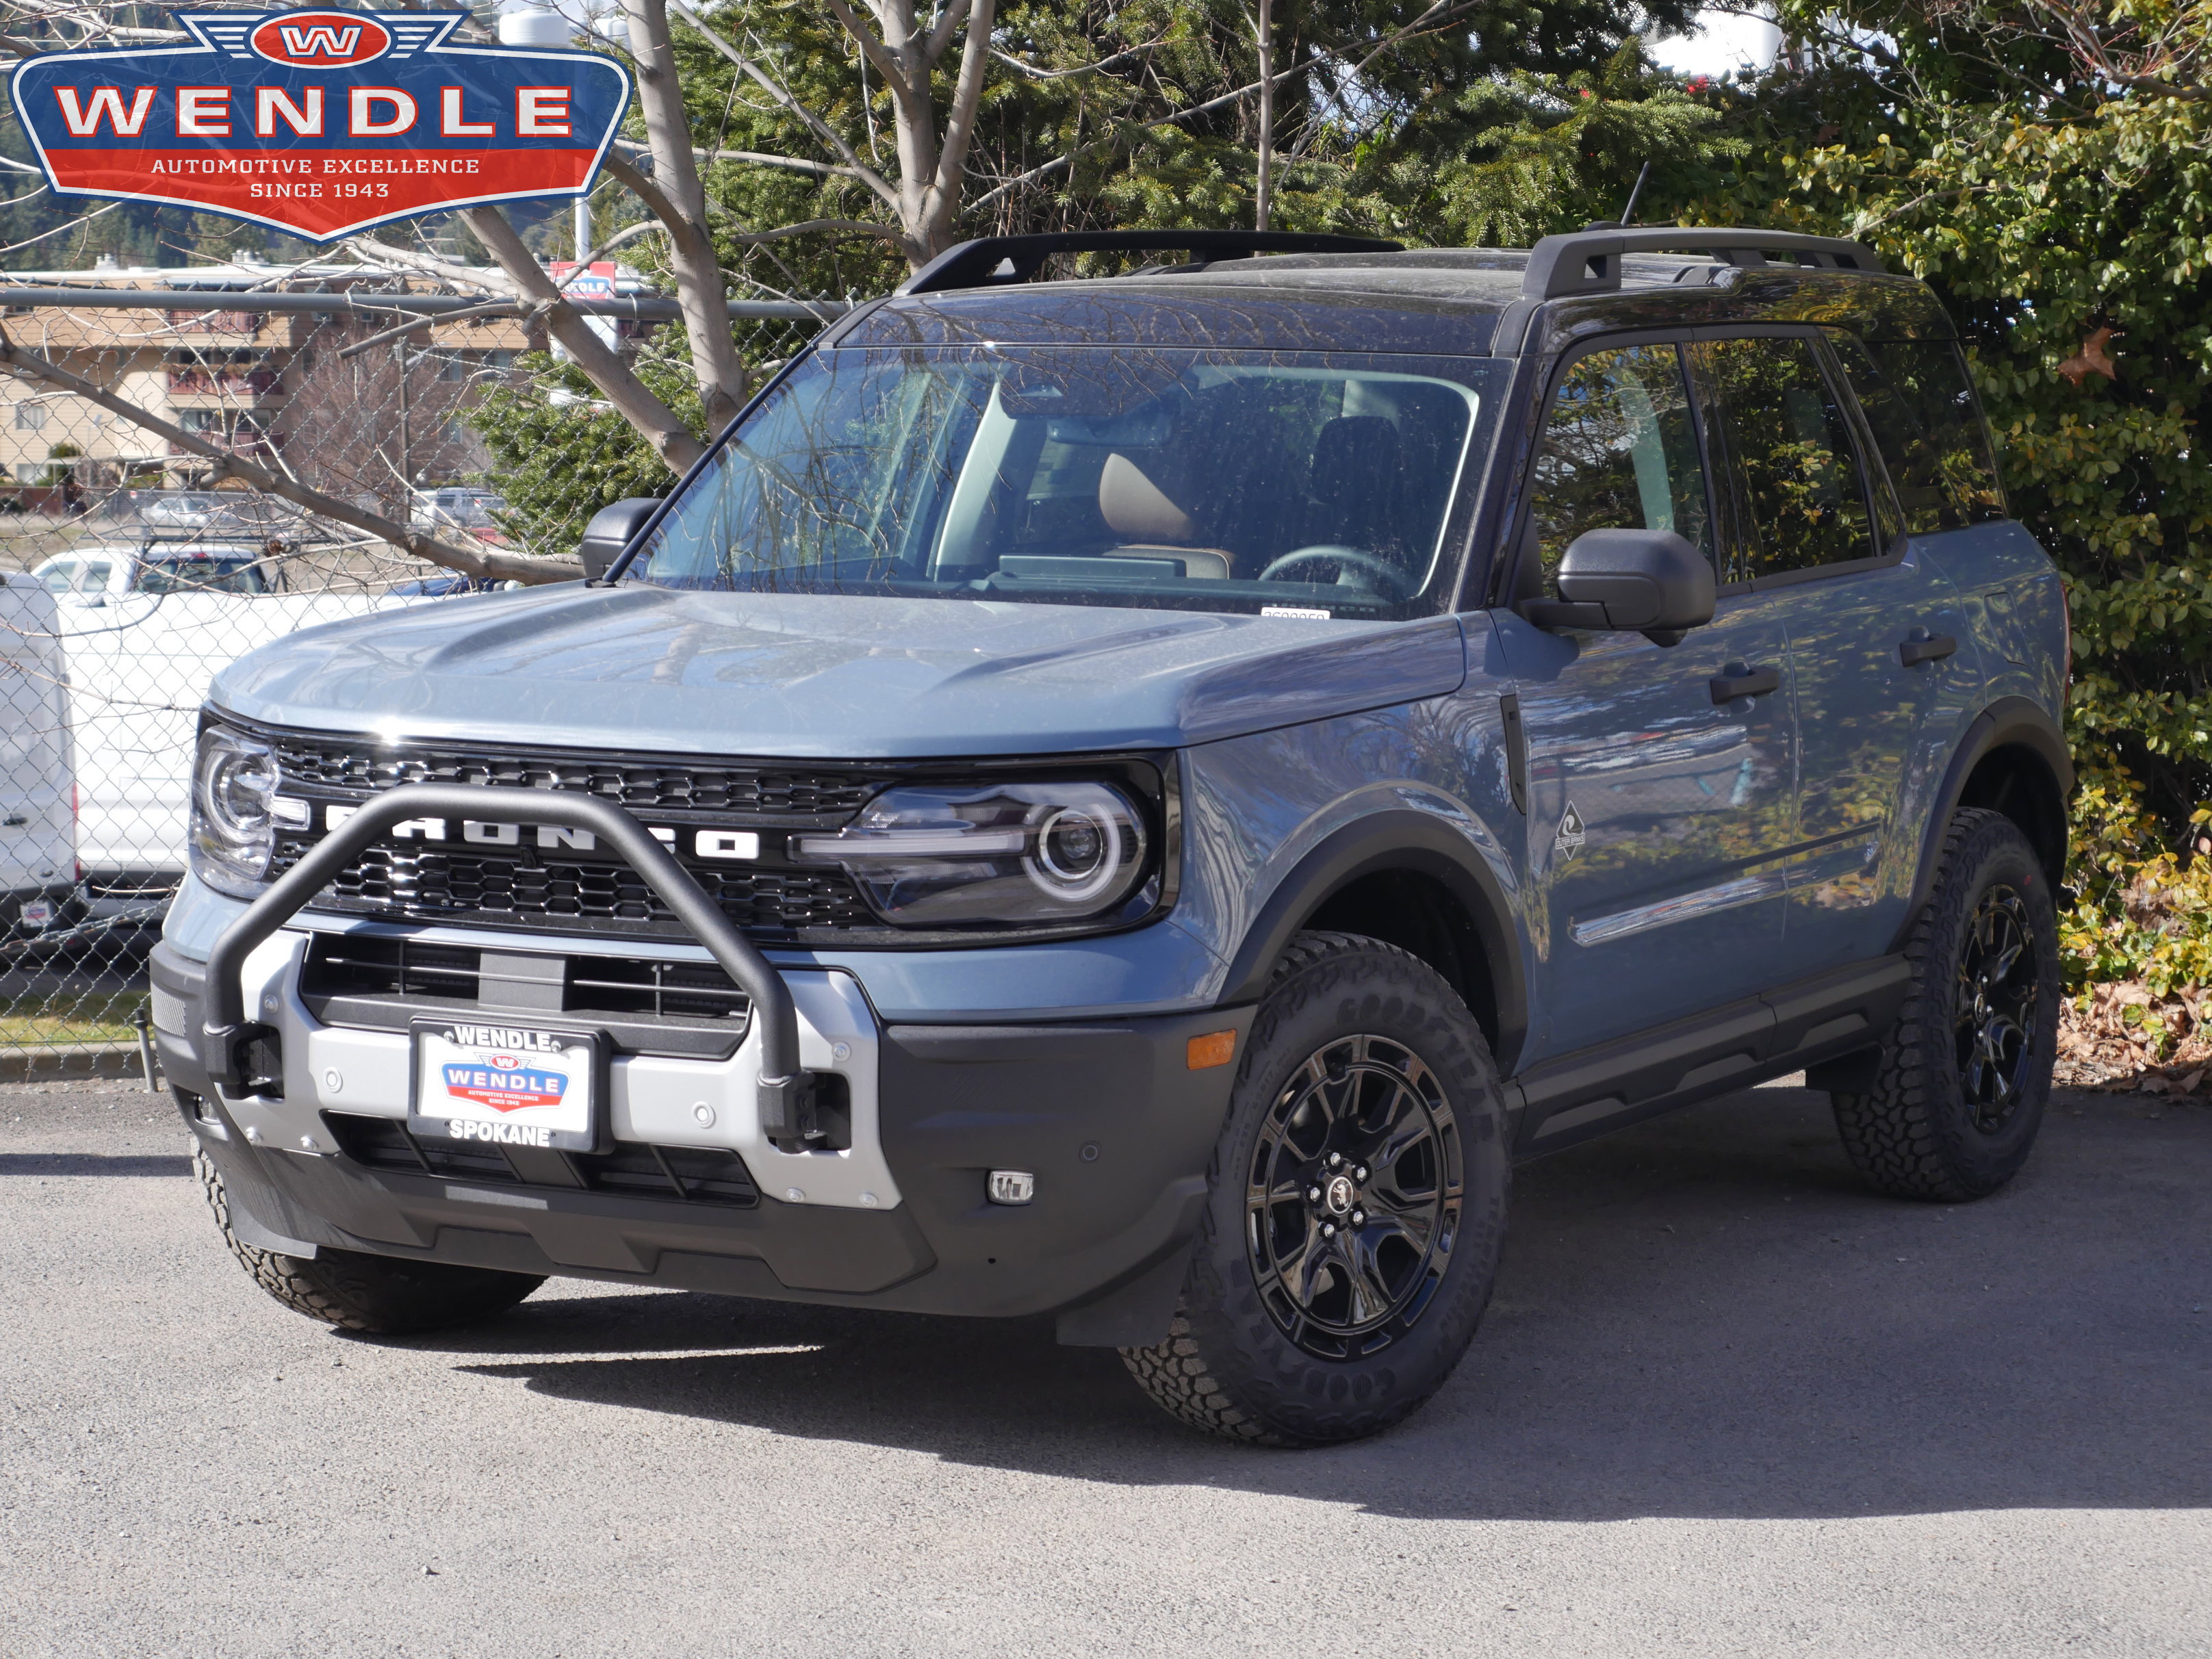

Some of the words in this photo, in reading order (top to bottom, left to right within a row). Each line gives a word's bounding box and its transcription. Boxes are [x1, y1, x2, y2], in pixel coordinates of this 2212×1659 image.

[1556, 838, 1571, 847] OUTER
[454, 1026, 552, 1052] WENDLE
[448, 1069, 559, 1093] WENDLE
[468, 1090, 504, 1098] AUTOMOTIVE
[504, 1093, 539, 1101] EXCELLENCE
[449, 1118, 550, 1147] SPOKANE
